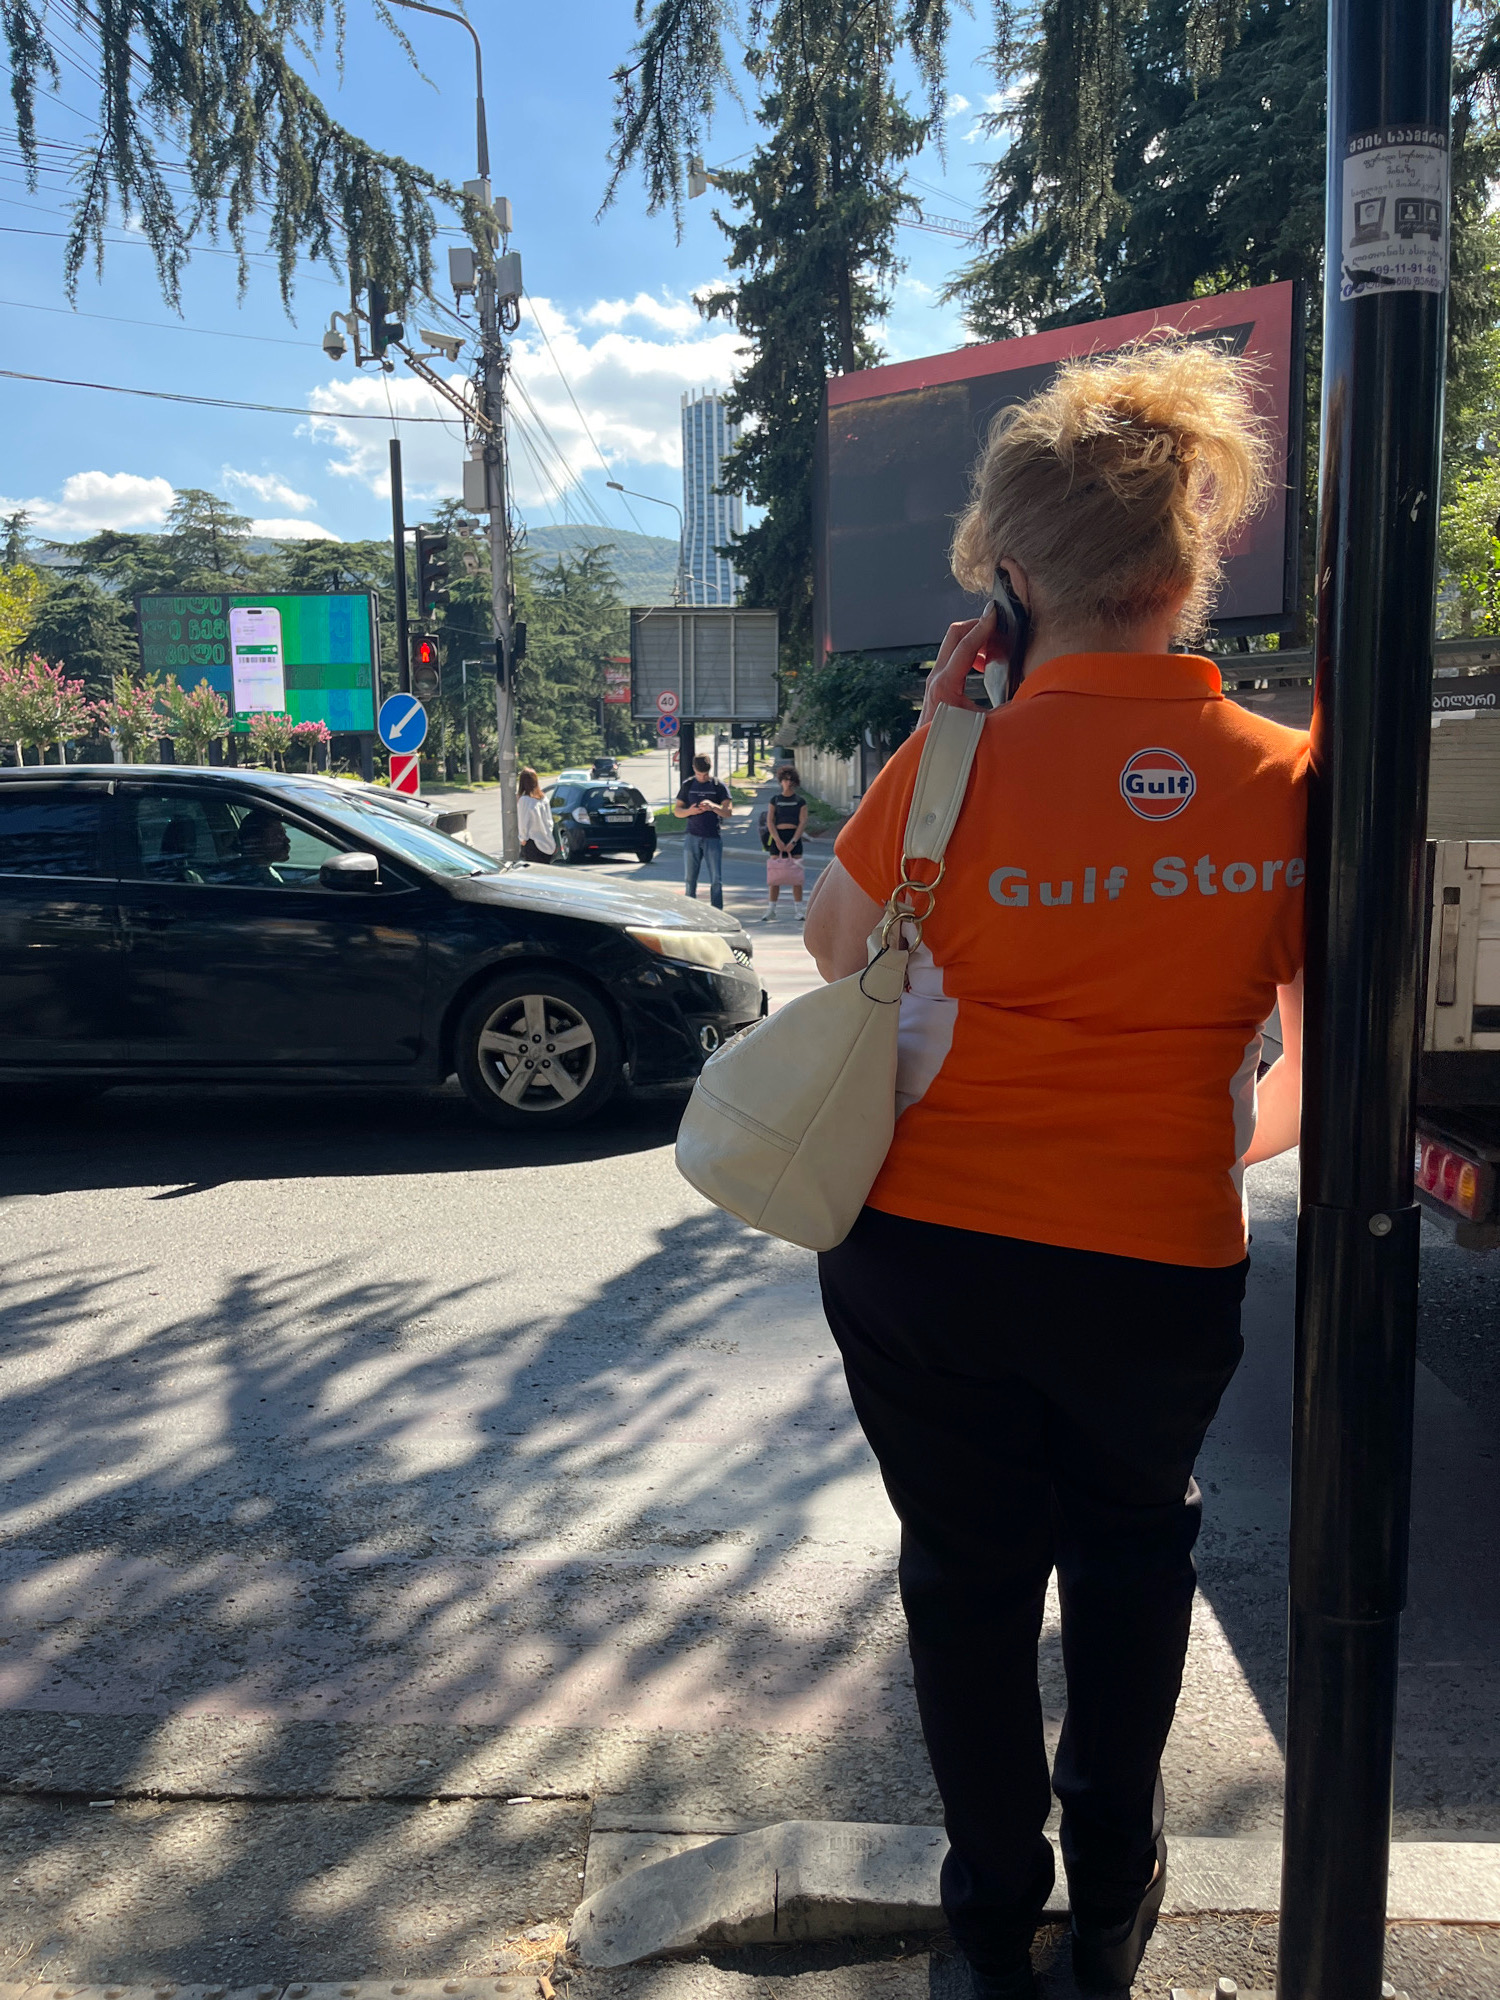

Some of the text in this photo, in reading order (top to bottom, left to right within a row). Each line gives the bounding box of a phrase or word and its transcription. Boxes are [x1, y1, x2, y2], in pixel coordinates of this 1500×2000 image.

[661, 697, 674, 706] 40
[1125, 773, 1190, 794] Gulf
[988, 854, 1305, 906] Gulf Store
